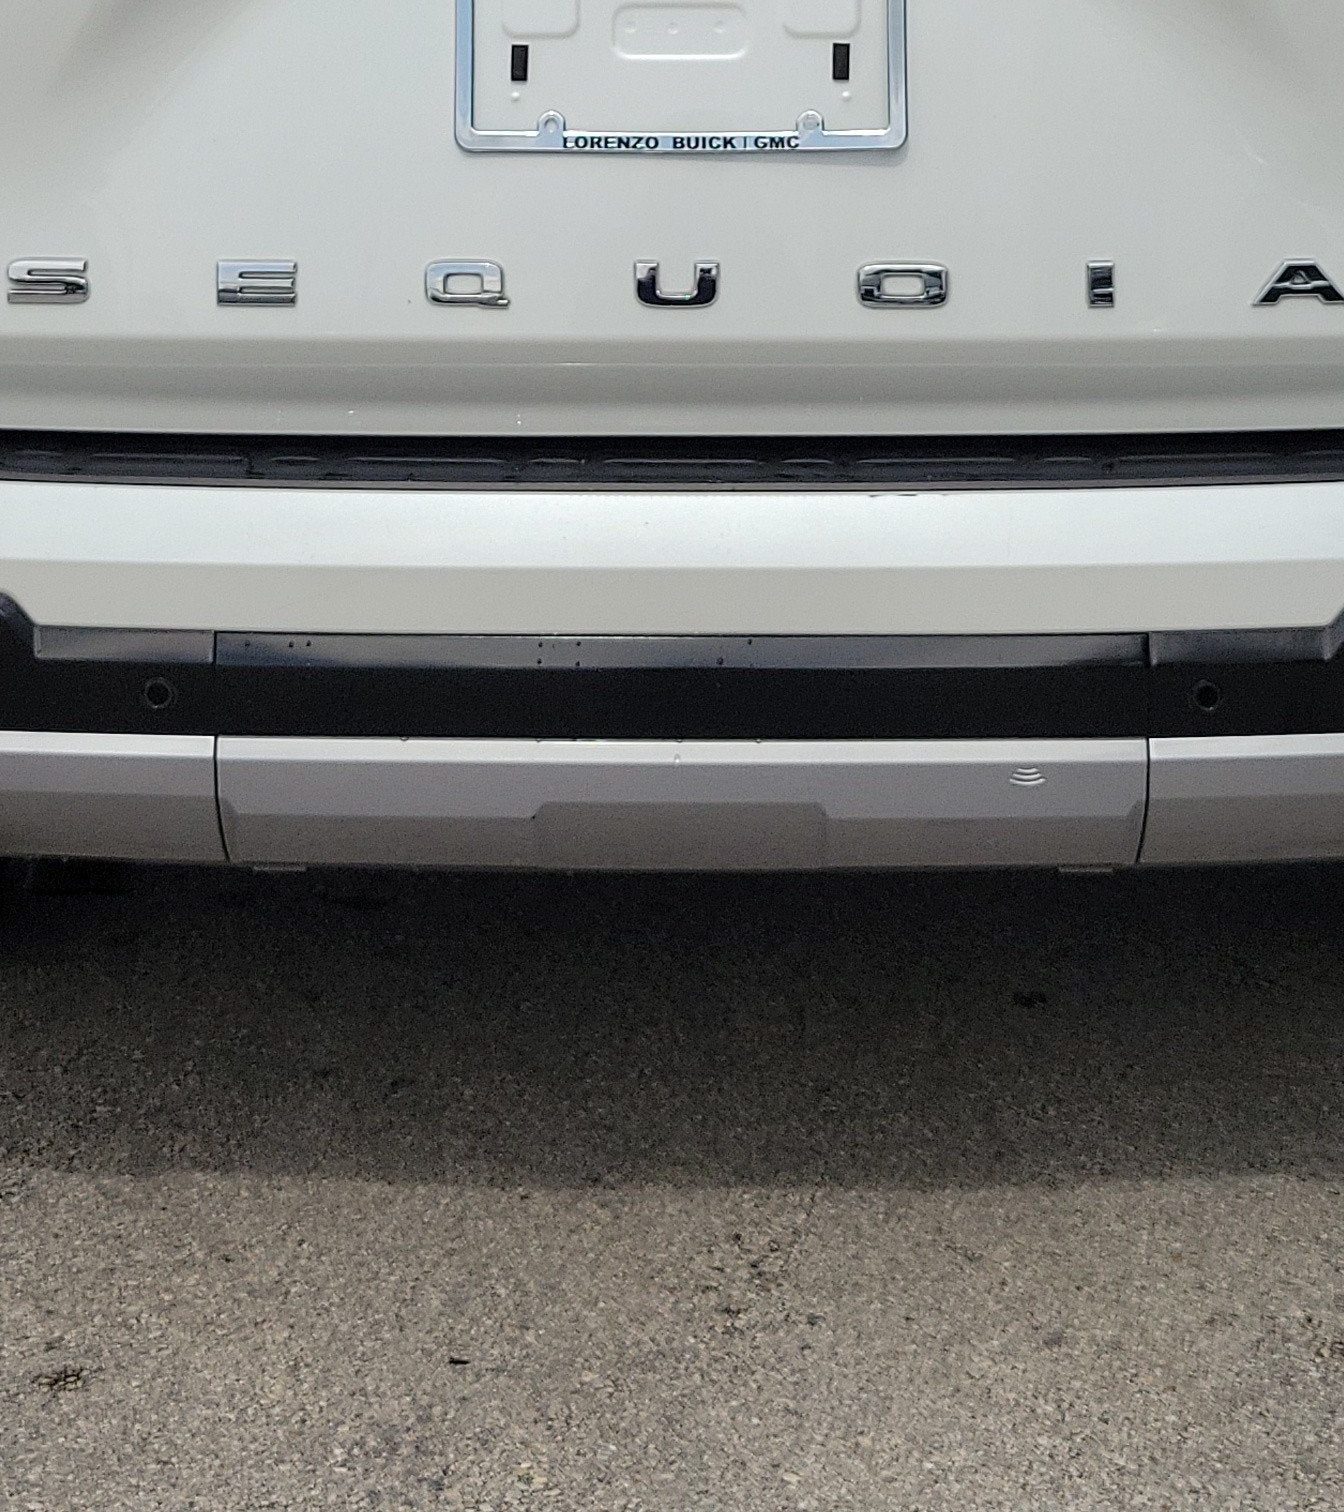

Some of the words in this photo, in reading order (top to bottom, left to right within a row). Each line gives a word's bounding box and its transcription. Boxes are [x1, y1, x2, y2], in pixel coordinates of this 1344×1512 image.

[562, 135, 660, 150] LORENZO
[671, 135, 737, 150] BUICK
[752, 135, 801, 149] GMC
